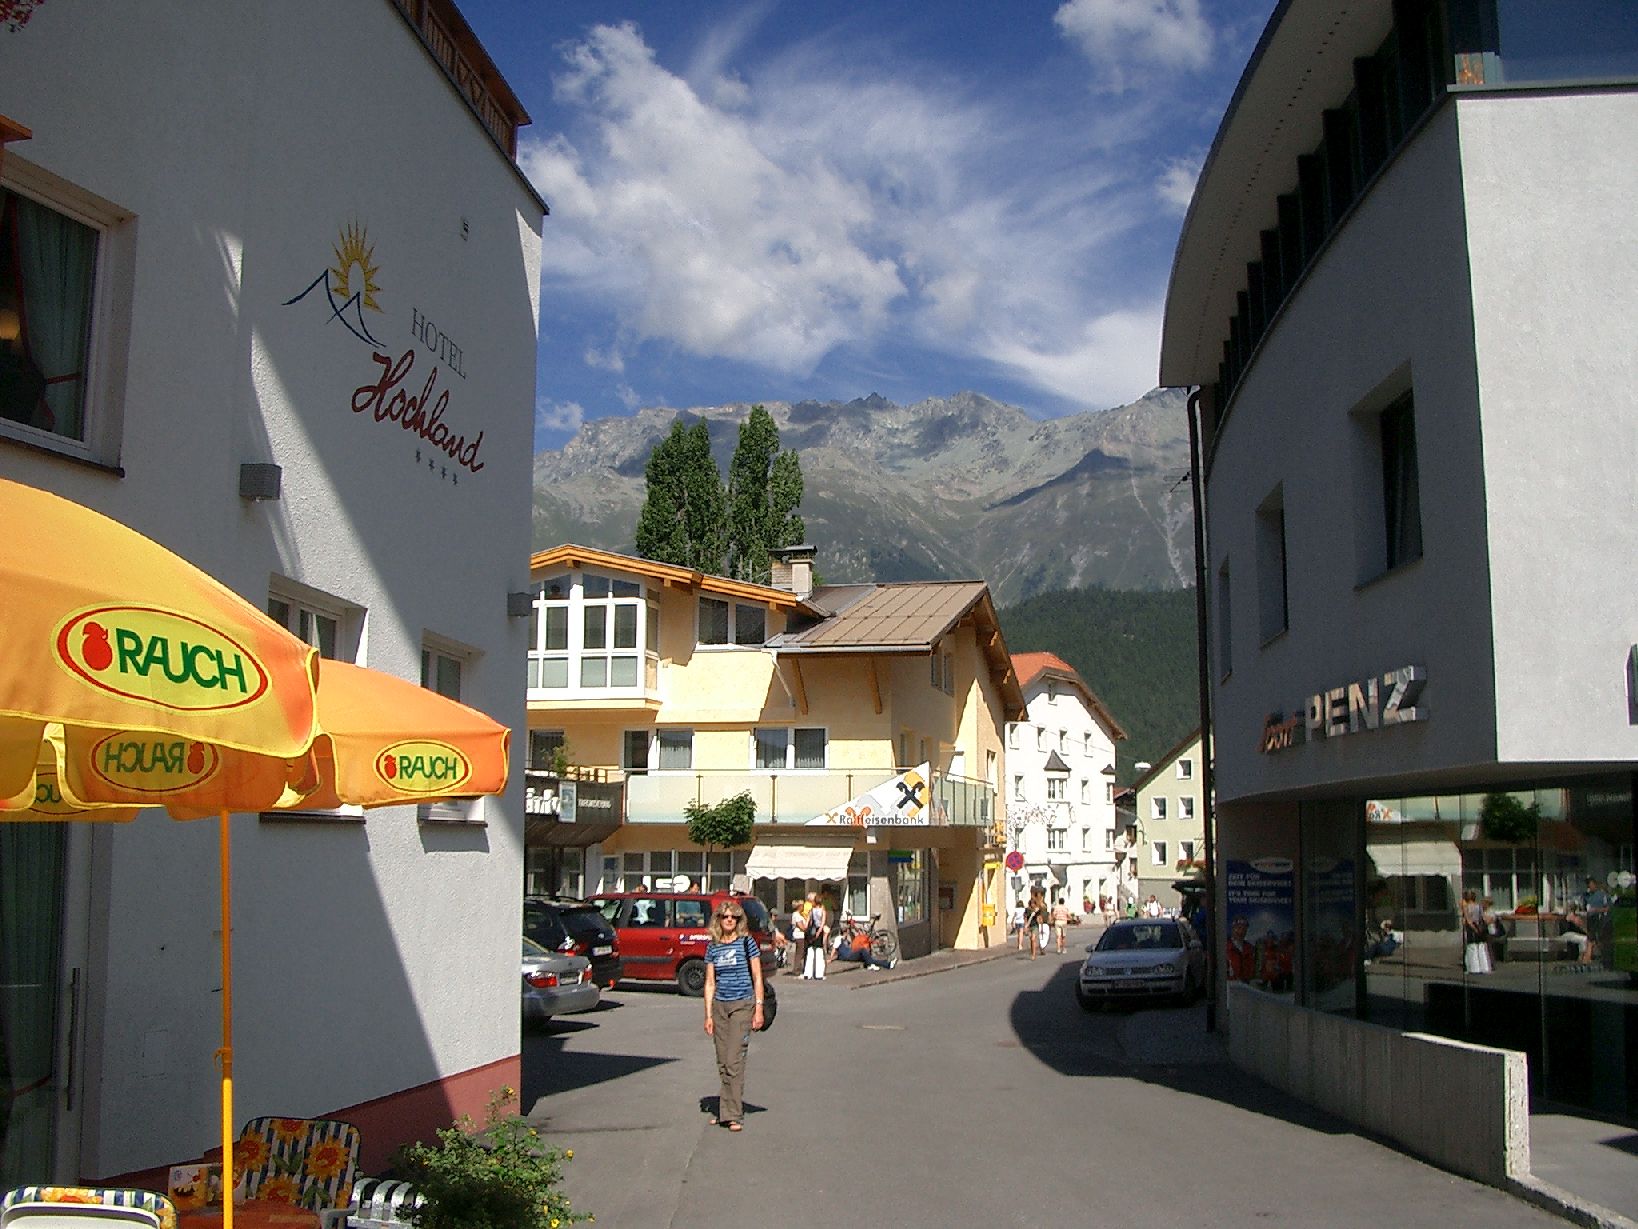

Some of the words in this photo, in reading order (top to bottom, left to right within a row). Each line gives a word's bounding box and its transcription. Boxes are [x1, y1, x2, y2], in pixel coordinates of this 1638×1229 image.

[411, 307, 467, 380] HOTEL
[351, 349, 485, 474] Hochland
[115, 627, 249, 695] RAUCH
[1304, 665, 1428, 742] PENZ
[398, 754, 459, 781] RAUCH
